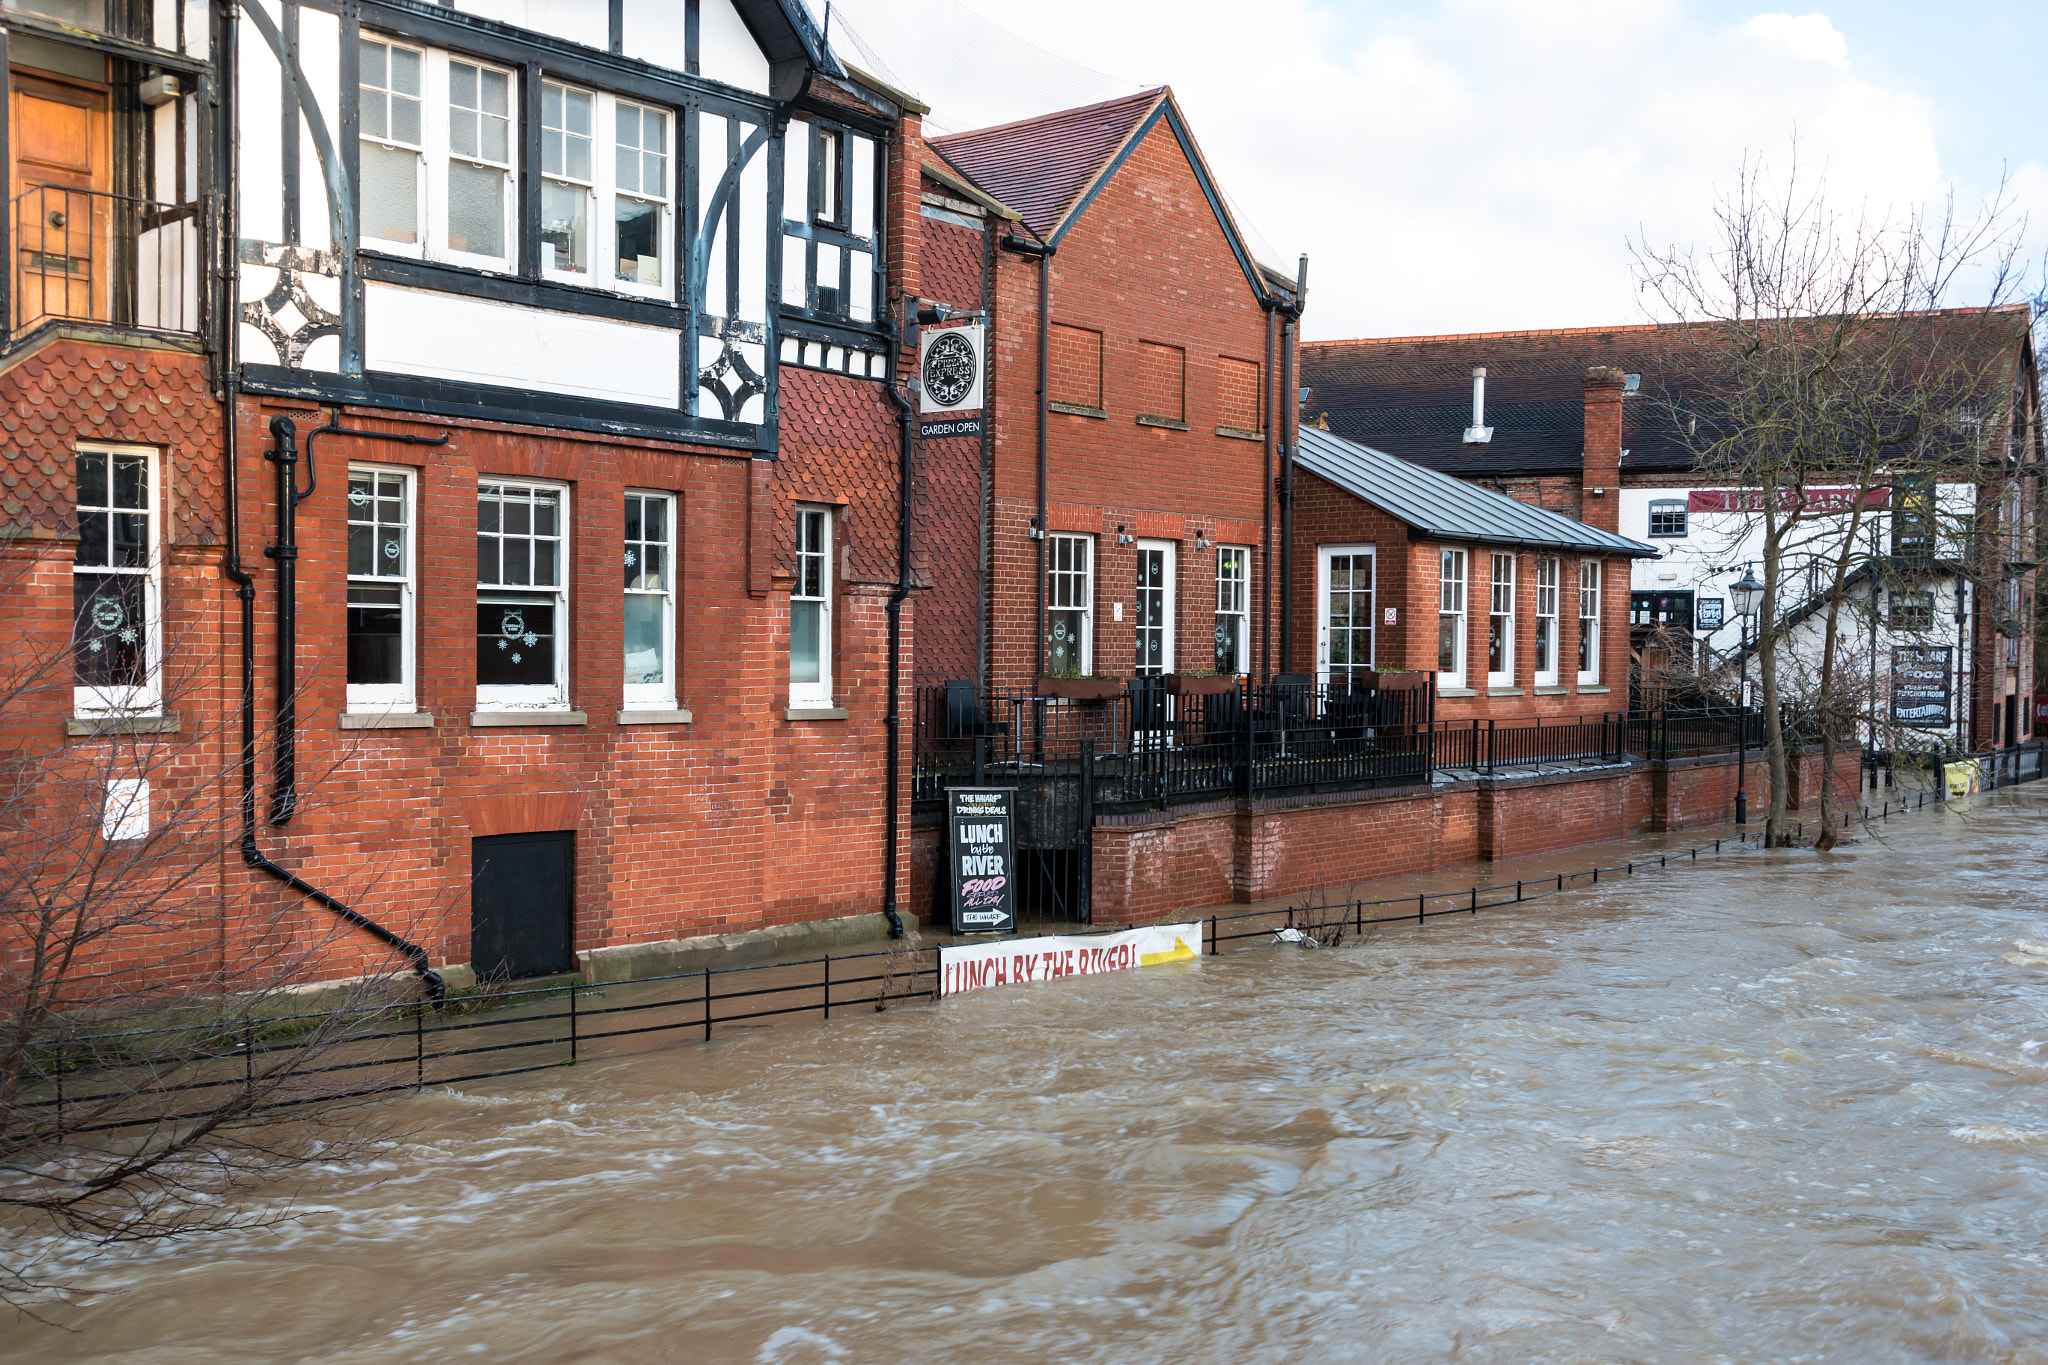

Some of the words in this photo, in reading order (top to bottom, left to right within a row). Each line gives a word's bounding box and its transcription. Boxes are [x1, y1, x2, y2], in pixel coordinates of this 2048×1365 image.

[938, 359, 963, 368] PIZZA
[930, 366, 970, 377] EXPRESS
[921, 423, 955, 436] GARDEN
[956, 421, 980, 434] OPEN
[1903, 671, 1944, 679] FOOD
[1927, 690, 1945, 698] ROOM
[959, 794, 974, 803] THE
[956, 805, 984, 814] DRINKS
[985, 805, 1006, 815] DEALS
[960, 823, 1003, 843] LUNCH
[970, 843, 981, 855] by
[981, 843, 994, 854] the
[962, 855, 1005, 876] RIVER
[961, 876, 1006, 896] FOOD
[963, 897, 983, 907] ALL
[983, 894, 1005, 906] DAY
[965, 913, 978, 921] THE
[1014, 953, 1038, 984] BY
[1043, 950, 1073, 980] THE
